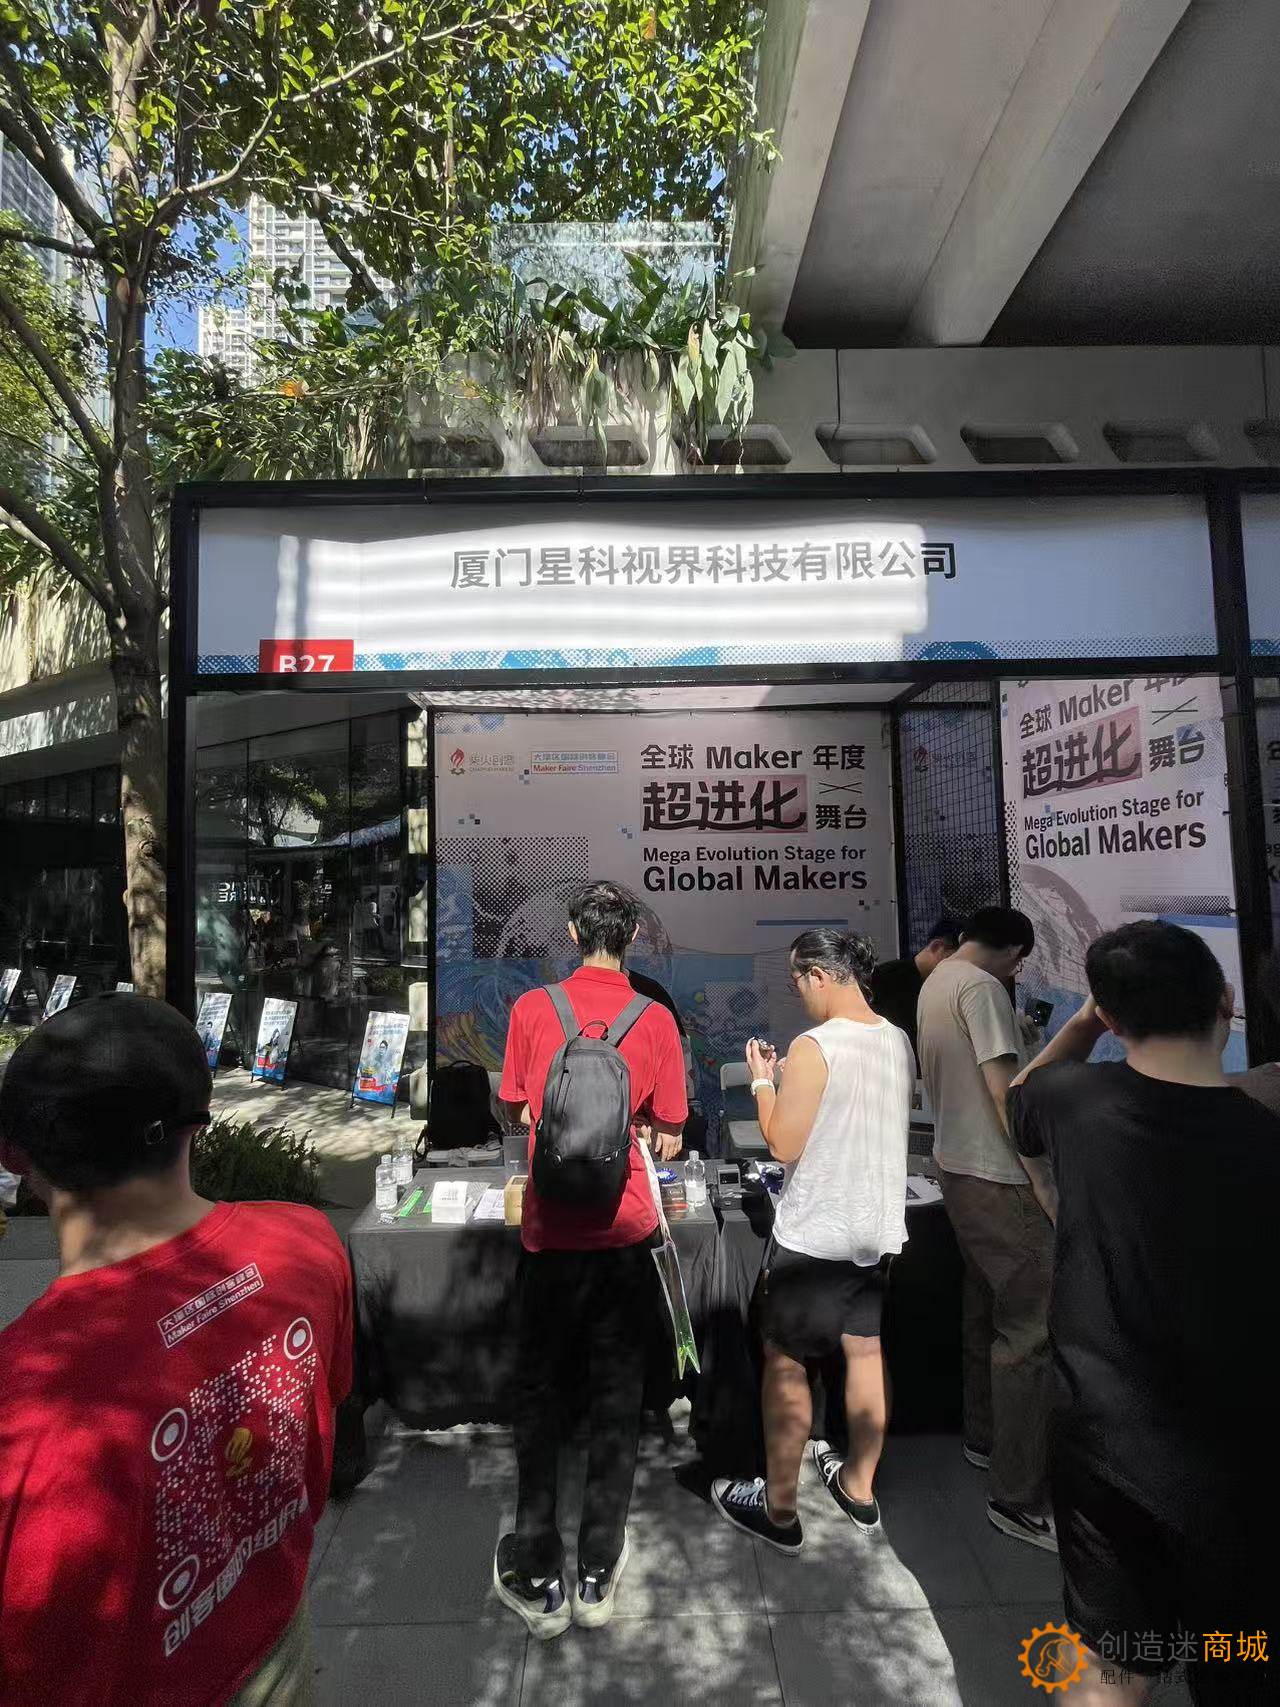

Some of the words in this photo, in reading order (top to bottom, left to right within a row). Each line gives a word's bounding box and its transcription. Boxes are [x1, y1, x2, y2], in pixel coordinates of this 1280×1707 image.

[450, 542, 957, 588] 厦门星科视界科技有限公司
[279, 654, 335, 673] B27
[1020, 704, 1052, 739] 全球
[1059, 678, 1135, 725] Maker
[534, 764, 557, 772] Maker
[640, 744, 694, 770] 全球
[706, 744, 802, 769] Maker
[813, 744, 865, 771] 年度
[1023, 720, 1142, 799] 超进化
[1149, 731, 1205, 772] 舞台
[642, 780, 807, 831] 超进化
[815, 804, 867, 830] 舞台
[1024, 815, 1053, 832] Mega
[1056, 806, 1117, 826] Evolution
[1122, 797, 1170, 817] Stage
[1176, 789, 1204, 809] for
[643, 847, 690, 865] Mega
[696, 846, 779, 861] Evolution
[784, 845, 836, 863] Stage
[841, 845, 866, 860] for
[1026, 827, 1090, 860] Global
[1099, 820, 1207, 855] Makers
[643, 865, 743, 891] Global
[754, 865, 868, 891] Makers
[167, 1320, 195, 1343] Maker
